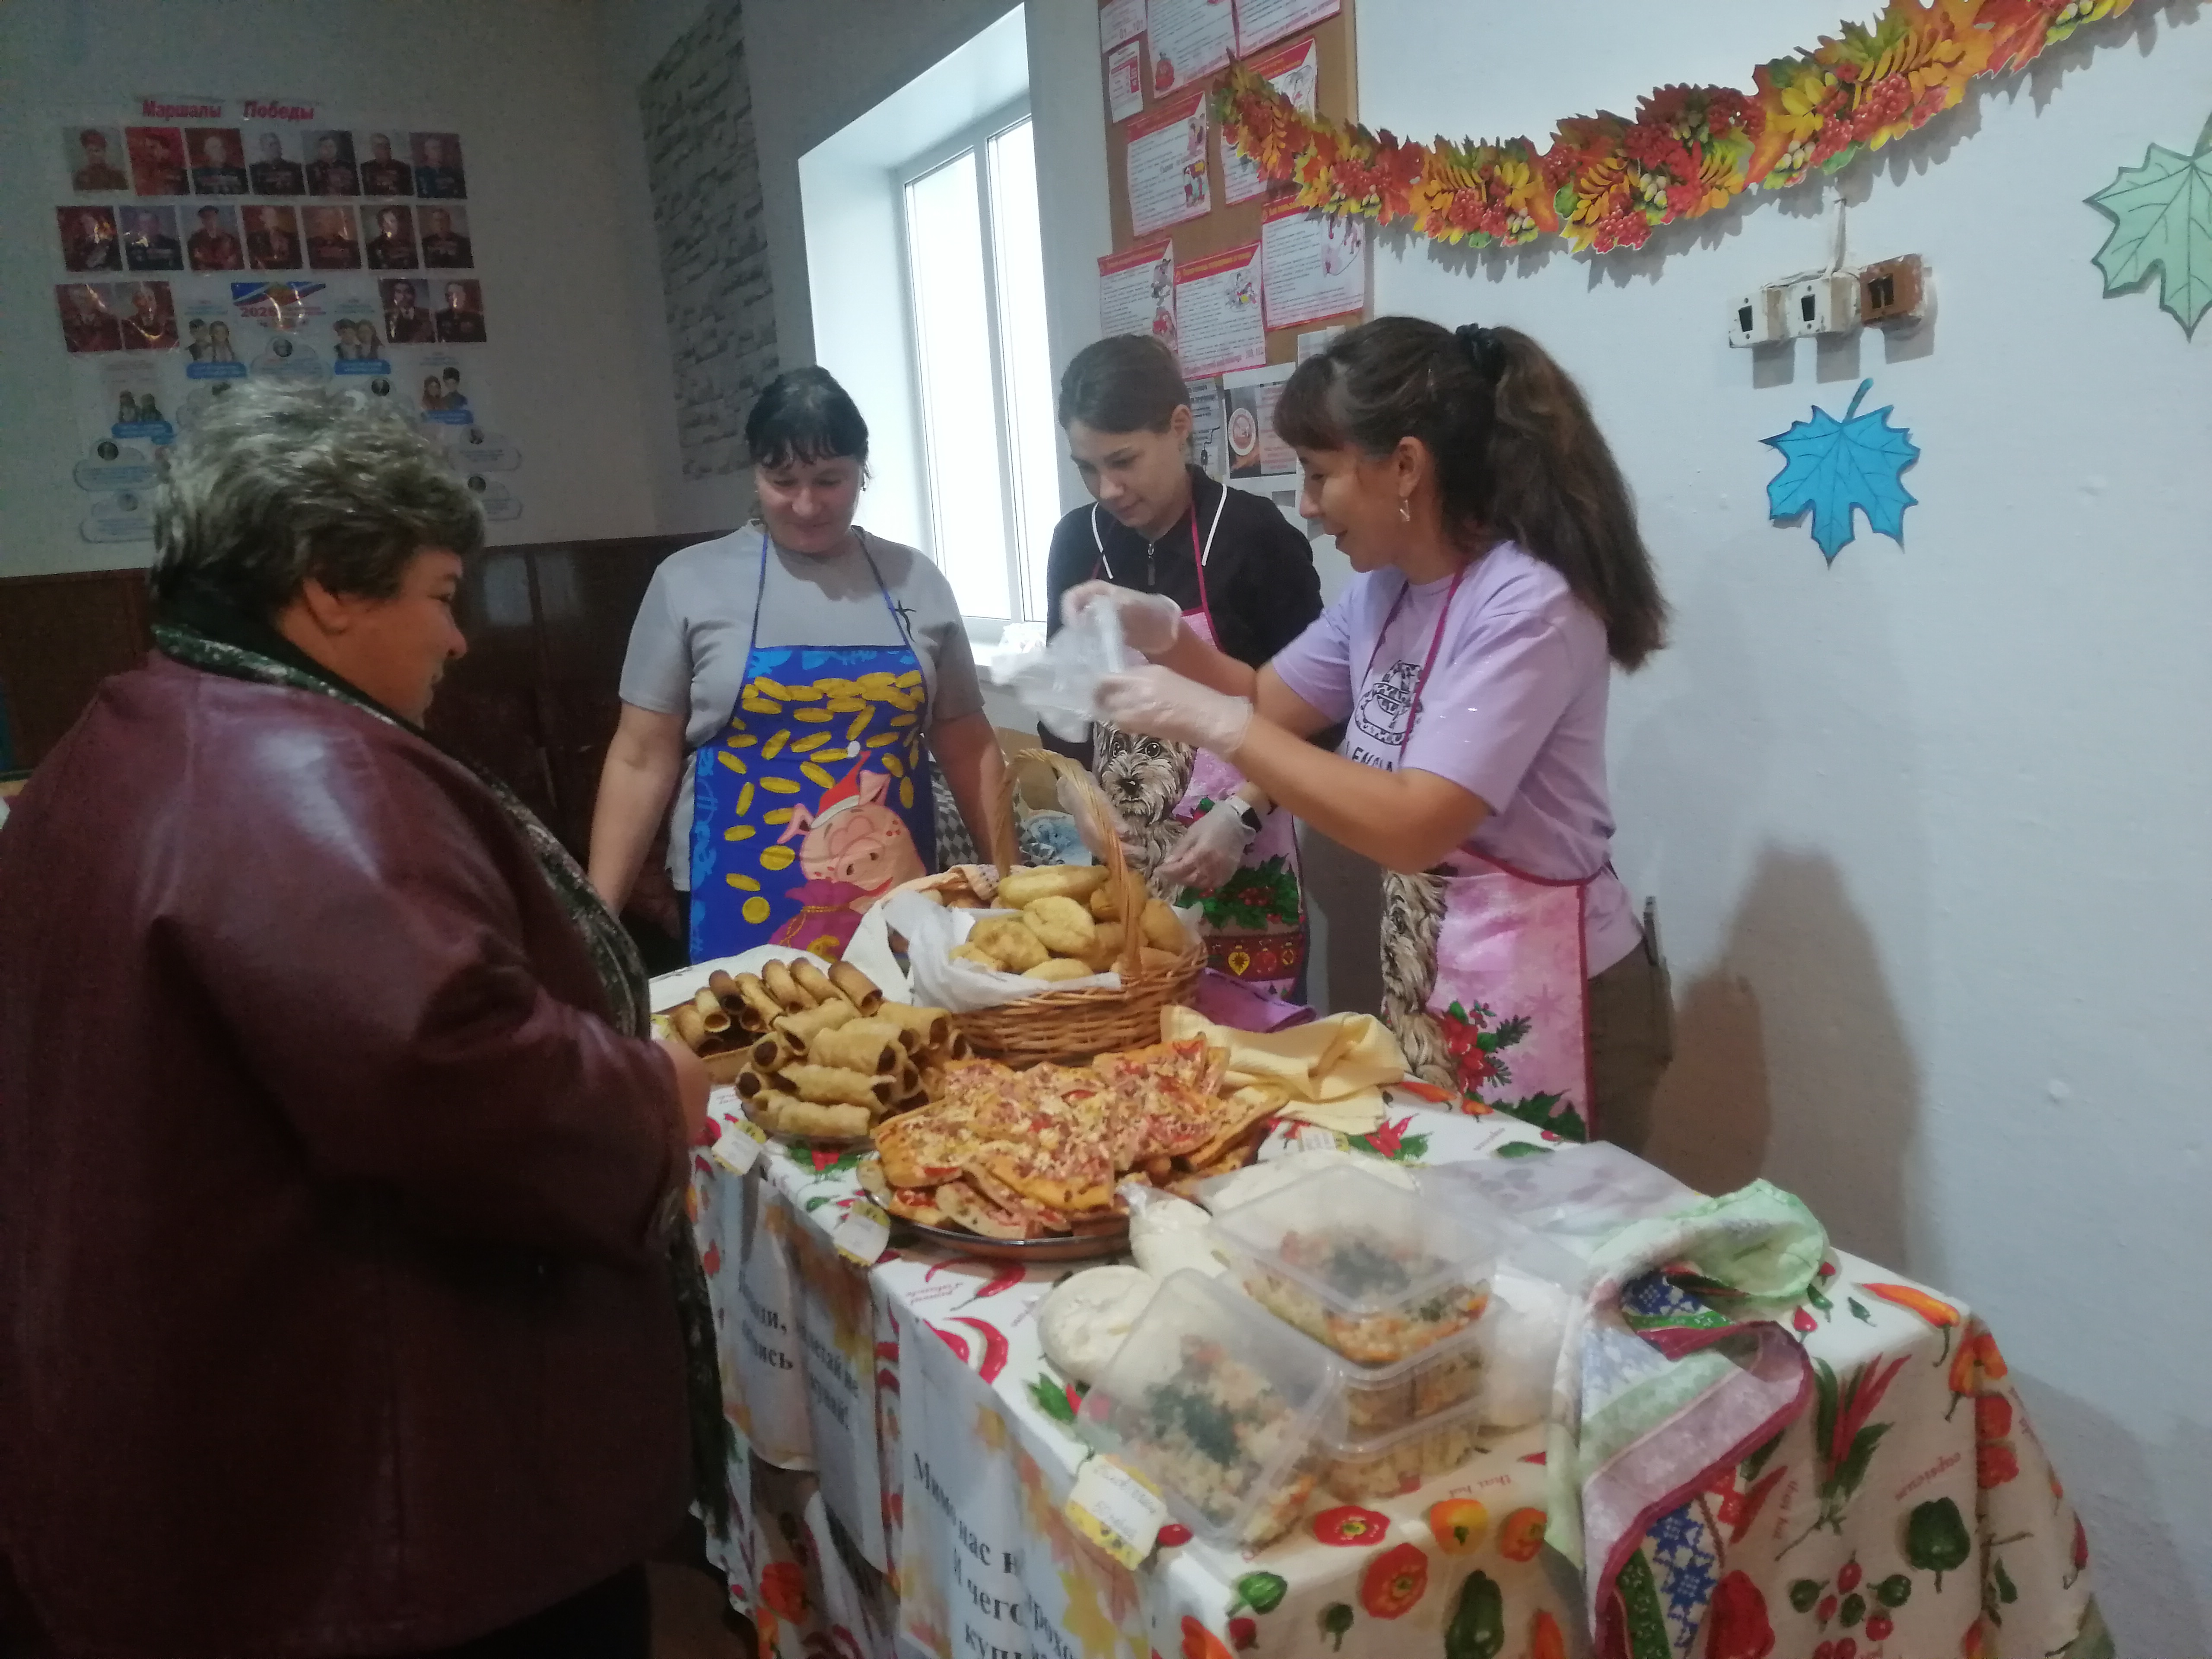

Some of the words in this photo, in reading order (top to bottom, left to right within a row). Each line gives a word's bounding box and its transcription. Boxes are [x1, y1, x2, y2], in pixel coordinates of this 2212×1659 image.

[142, 100, 221, 121] Маршалы
[243, 100, 314, 122] Победы
[959, 1520, 991, 1566] нас
